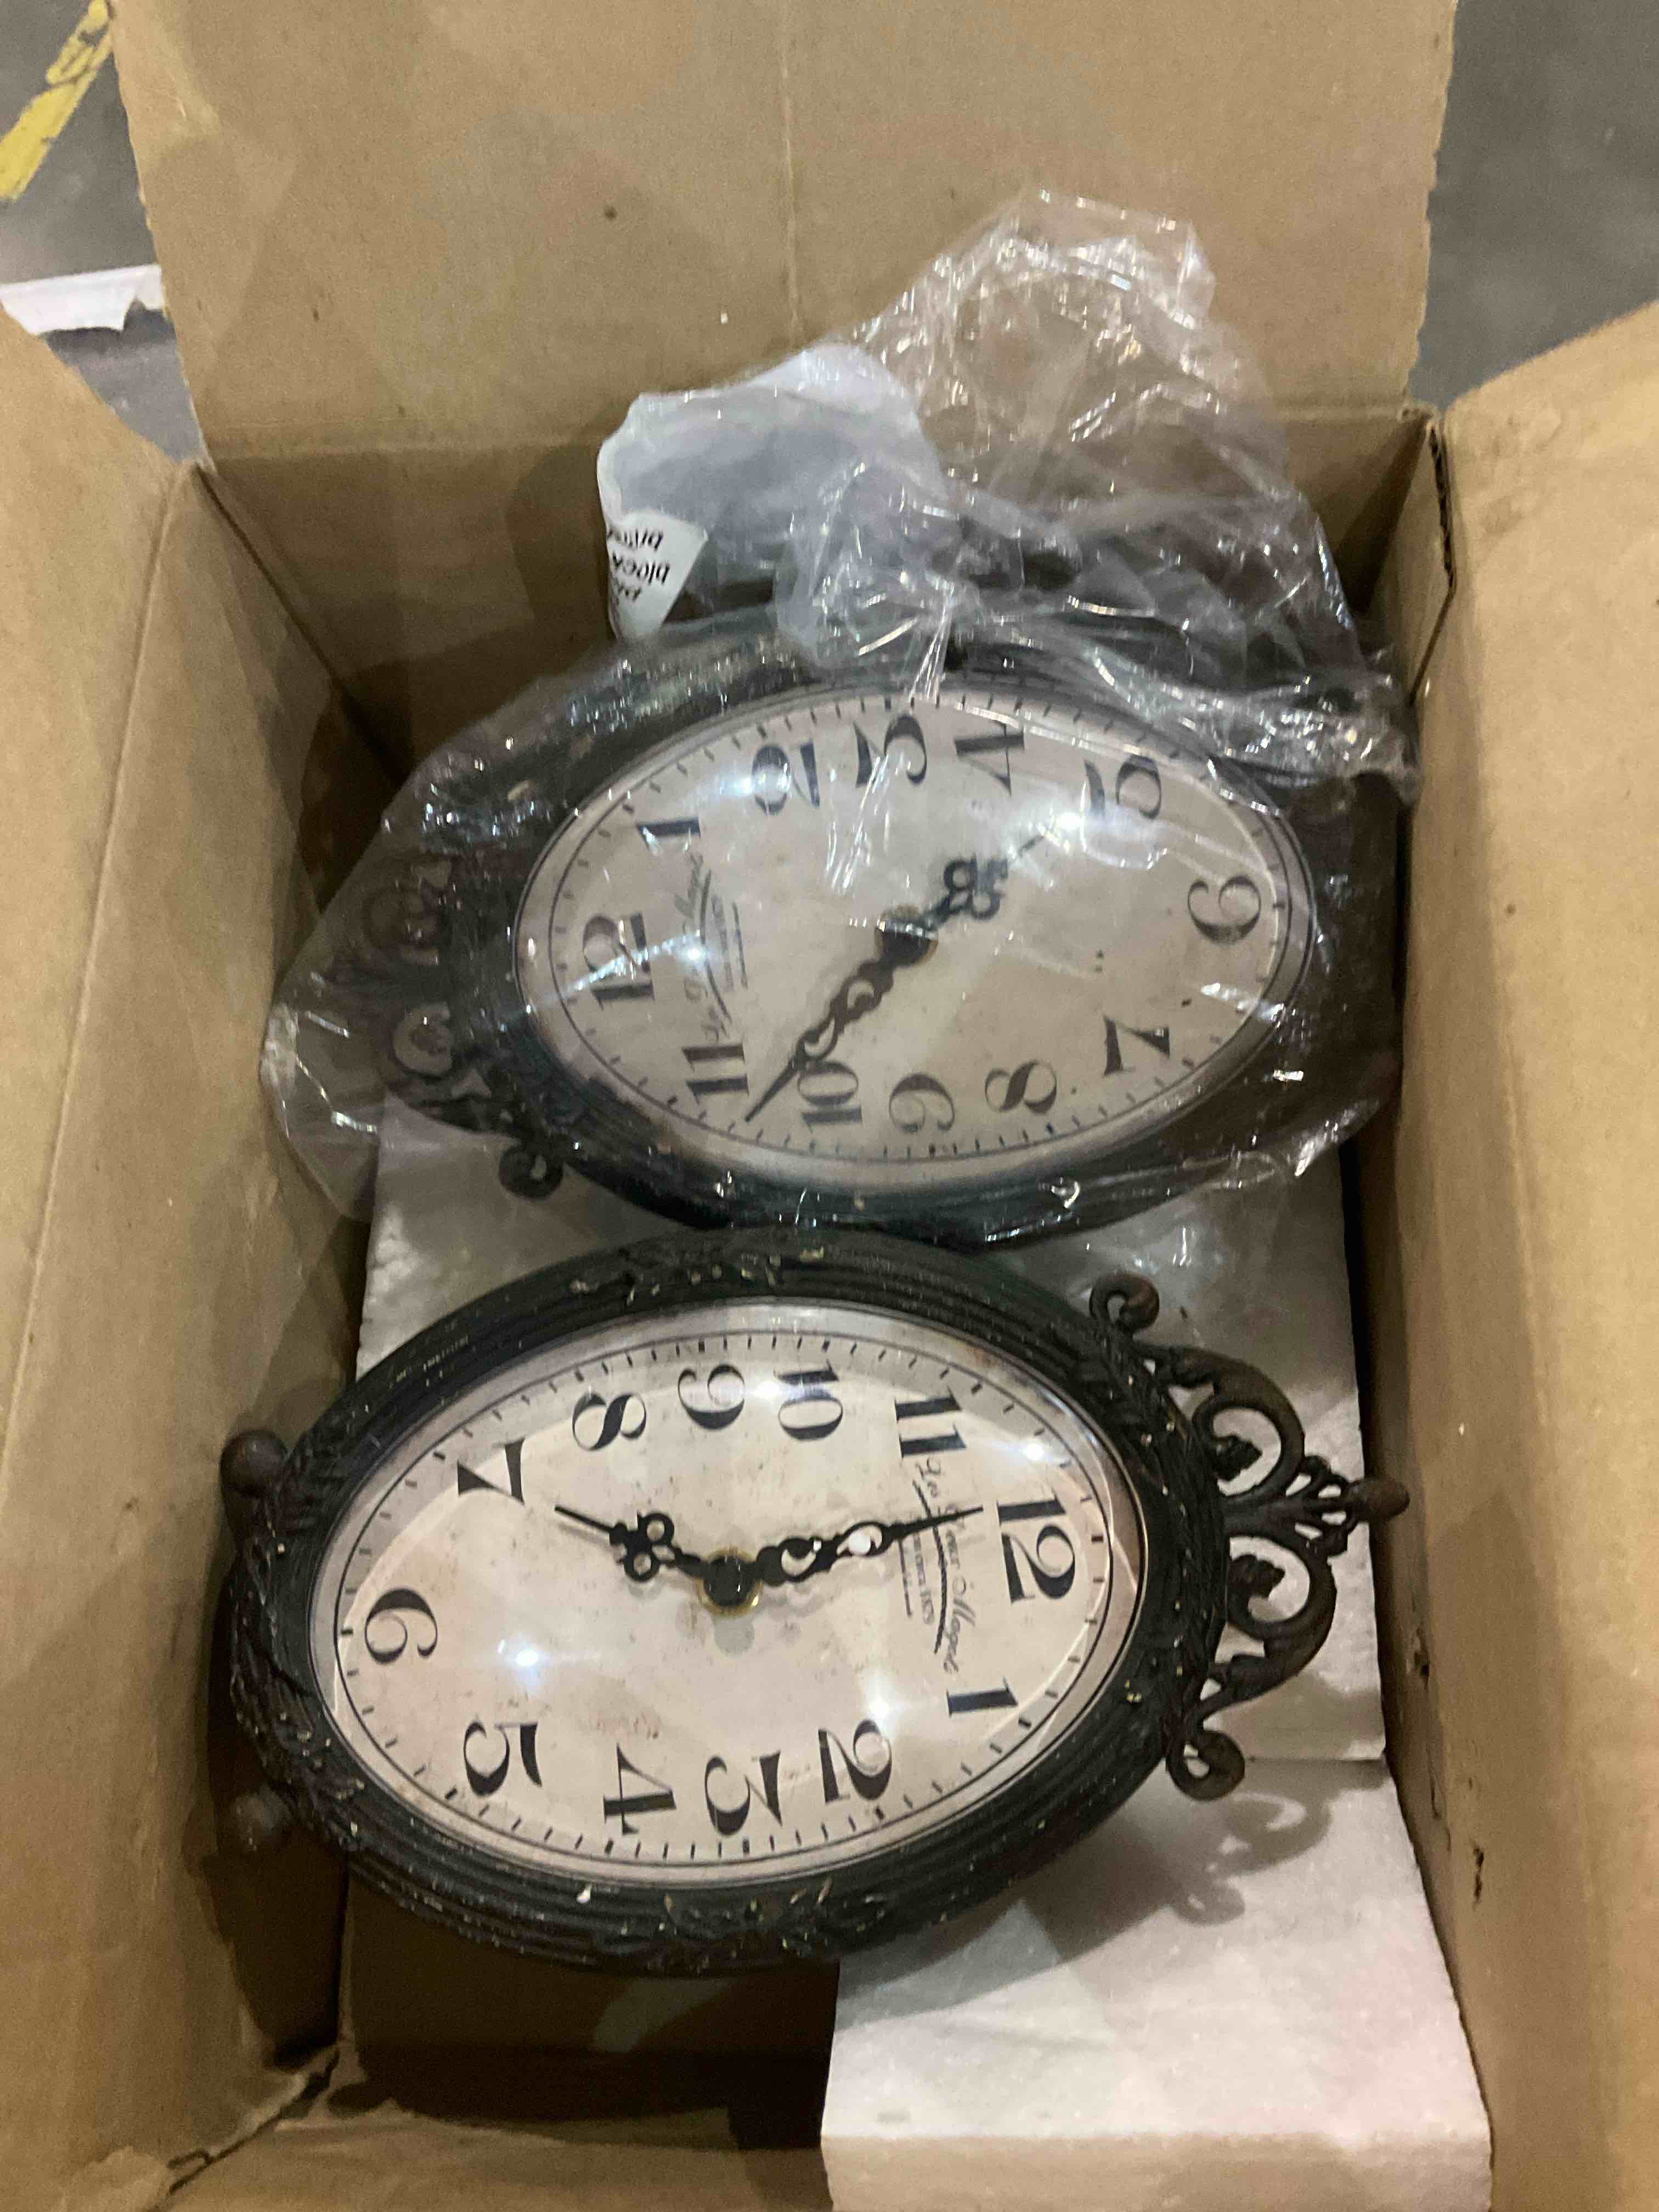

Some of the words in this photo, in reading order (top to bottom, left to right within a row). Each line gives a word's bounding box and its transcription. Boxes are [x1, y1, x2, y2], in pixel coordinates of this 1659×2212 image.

[750, 741, 821, 816] 2
[853, 714, 928, 787] 3
[954, 723, 1025, 795] 4
[1082, 755, 1163, 821] 5
[636, 816, 701, 853] 1
[1187, 875, 1261, 943] 6
[582, 912, 654, 1008] 12
[682, 1042, 749, 1099] 11
[1103, 1014, 1170, 1077] 7
[796, 1059, 862, 1128] 10
[888, 1072, 955, 1135] 9
[983, 1058, 1058, 1116] 8
[571, 1392, 647, 1453] 8
[677, 1363, 746, 1432] 9
[773, 1359, 844, 1442] 10
[894, 1390, 966, 1458] 11
[456, 1438, 526, 1505] 7
[996, 1497, 1075, 1602] 12
[364, 1587, 438, 1665] 6
[946, 1678, 1018, 1718] 1
[462, 1718, 542, 1797] 5
[603, 1742, 676, 1836] 4
[817, 1719, 892, 1805] 2
[703, 1750, 782, 1837] 3
